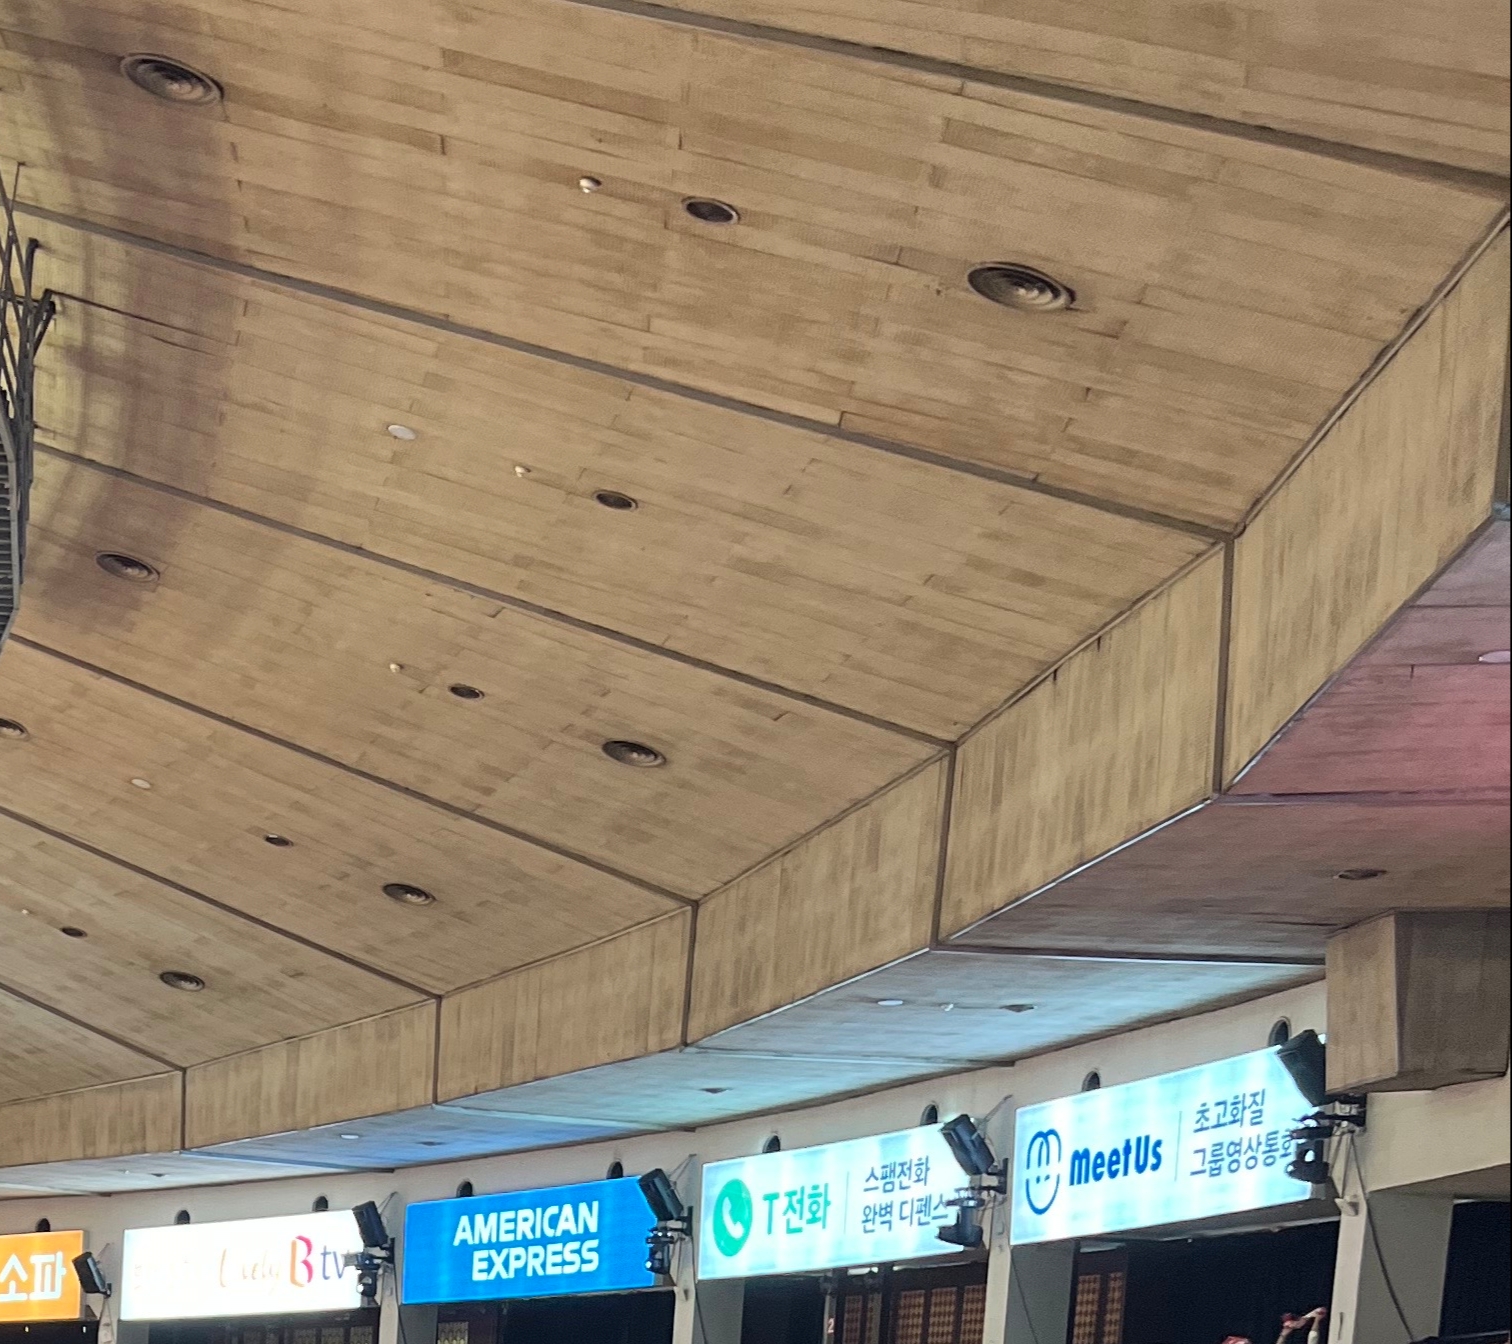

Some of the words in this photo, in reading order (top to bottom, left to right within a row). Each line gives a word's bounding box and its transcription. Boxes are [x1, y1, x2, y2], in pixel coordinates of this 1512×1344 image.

[1193, 1088, 1267, 1134] 초고화질
[863, 1155, 931, 1194] 스팸전화
[1069, 1133, 1163, 1186] meetUs
[453, 1200, 600, 1247] AMERICAN
[861, 1200, 894, 1234] 완벽
[472, 1240, 599, 1281] EXPRESS
